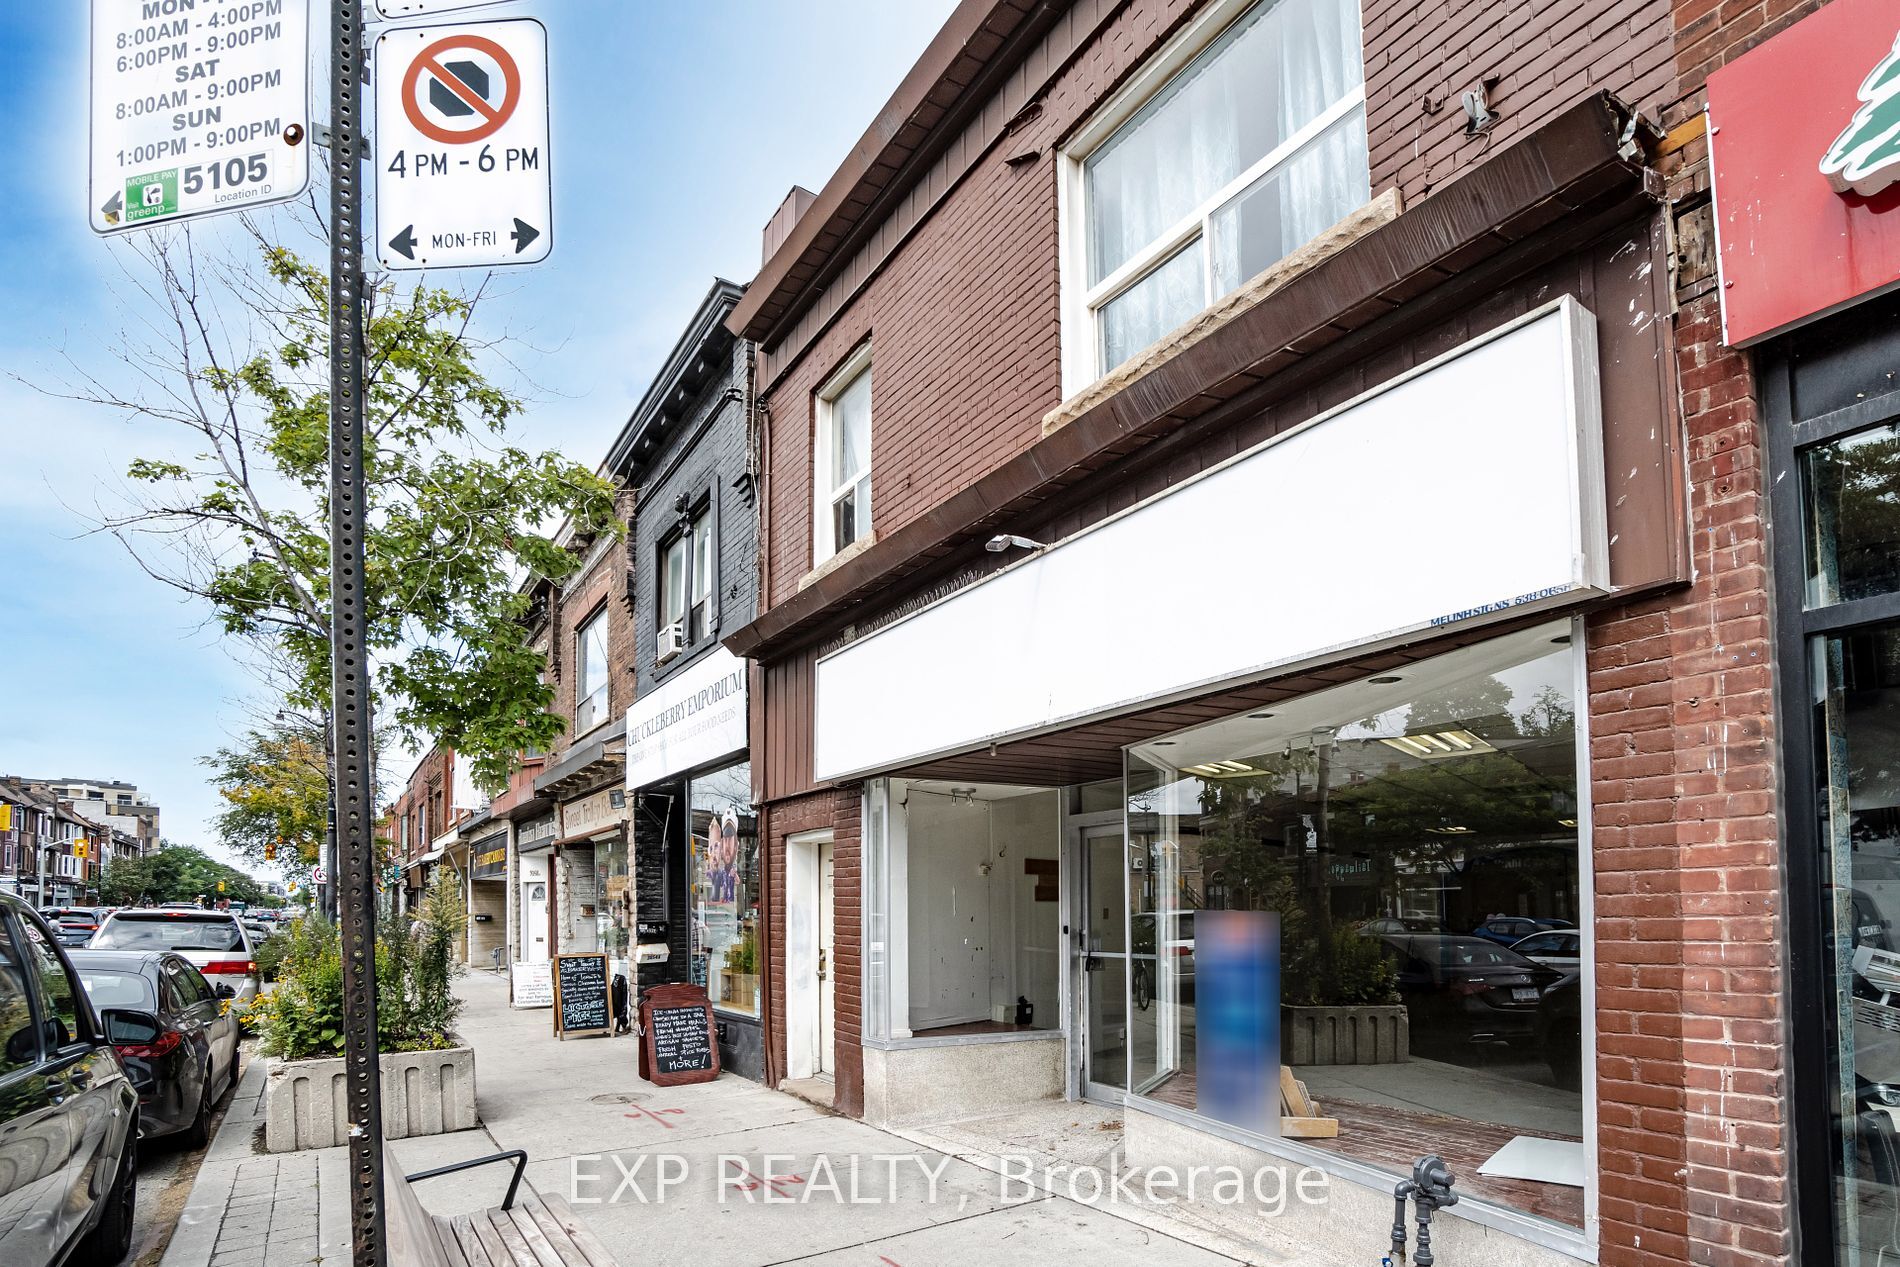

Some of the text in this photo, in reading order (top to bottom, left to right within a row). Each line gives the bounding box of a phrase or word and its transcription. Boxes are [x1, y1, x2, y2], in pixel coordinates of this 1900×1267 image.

[116, 18, 189, 50] 8:00AM
[207, 0, 282, 29] 4:00PM
[142, 0, 195, 20] MON
[117, 42, 188, 73] 6:00PM
[207, 21, 281, 53] 9:00PM
[175, 58, 220, 83] SAT
[115, 89, 188, 120] 8:00AM
[207, 69, 281, 101] 9:00PM
[172, 106, 221, 131] SUN
[116, 137, 187, 167] 1:00PM
[206, 117, 280, 149] 9:00PM
[127, 169, 177, 187] MOBILE PAY
[183, 153, 268, 194] 5105
[388, 150, 406, 178] 4
[415, 152, 447, 177] PM
[478, 144, 496, 173] 6
[506, 147, 539, 171] PM
[214, 184, 272, 204] Location ID
[432, 231, 496, 249] MON-FRI
[628, 668, 742, 747] CHUCKLEBERRY EMPORIUM
